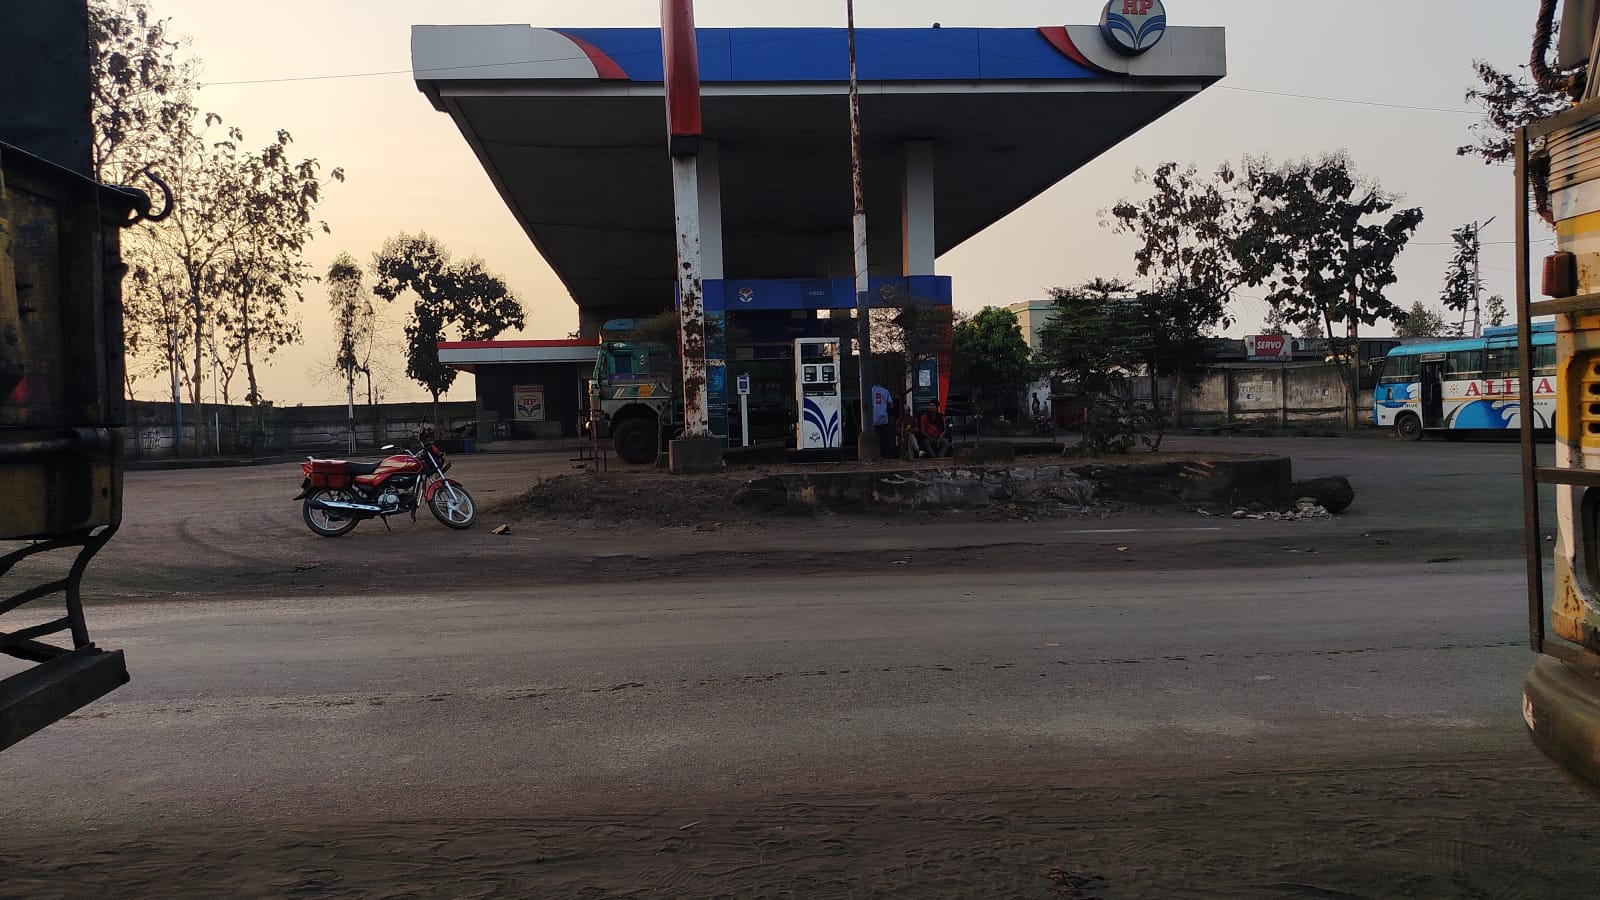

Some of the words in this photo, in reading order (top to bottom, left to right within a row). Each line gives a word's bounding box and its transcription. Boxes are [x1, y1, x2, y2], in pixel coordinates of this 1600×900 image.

[1122, 0, 1153, 15] HP
[1256, 341, 1281, 349] SERVO
[1464, 377, 1555, 396] ALIA
